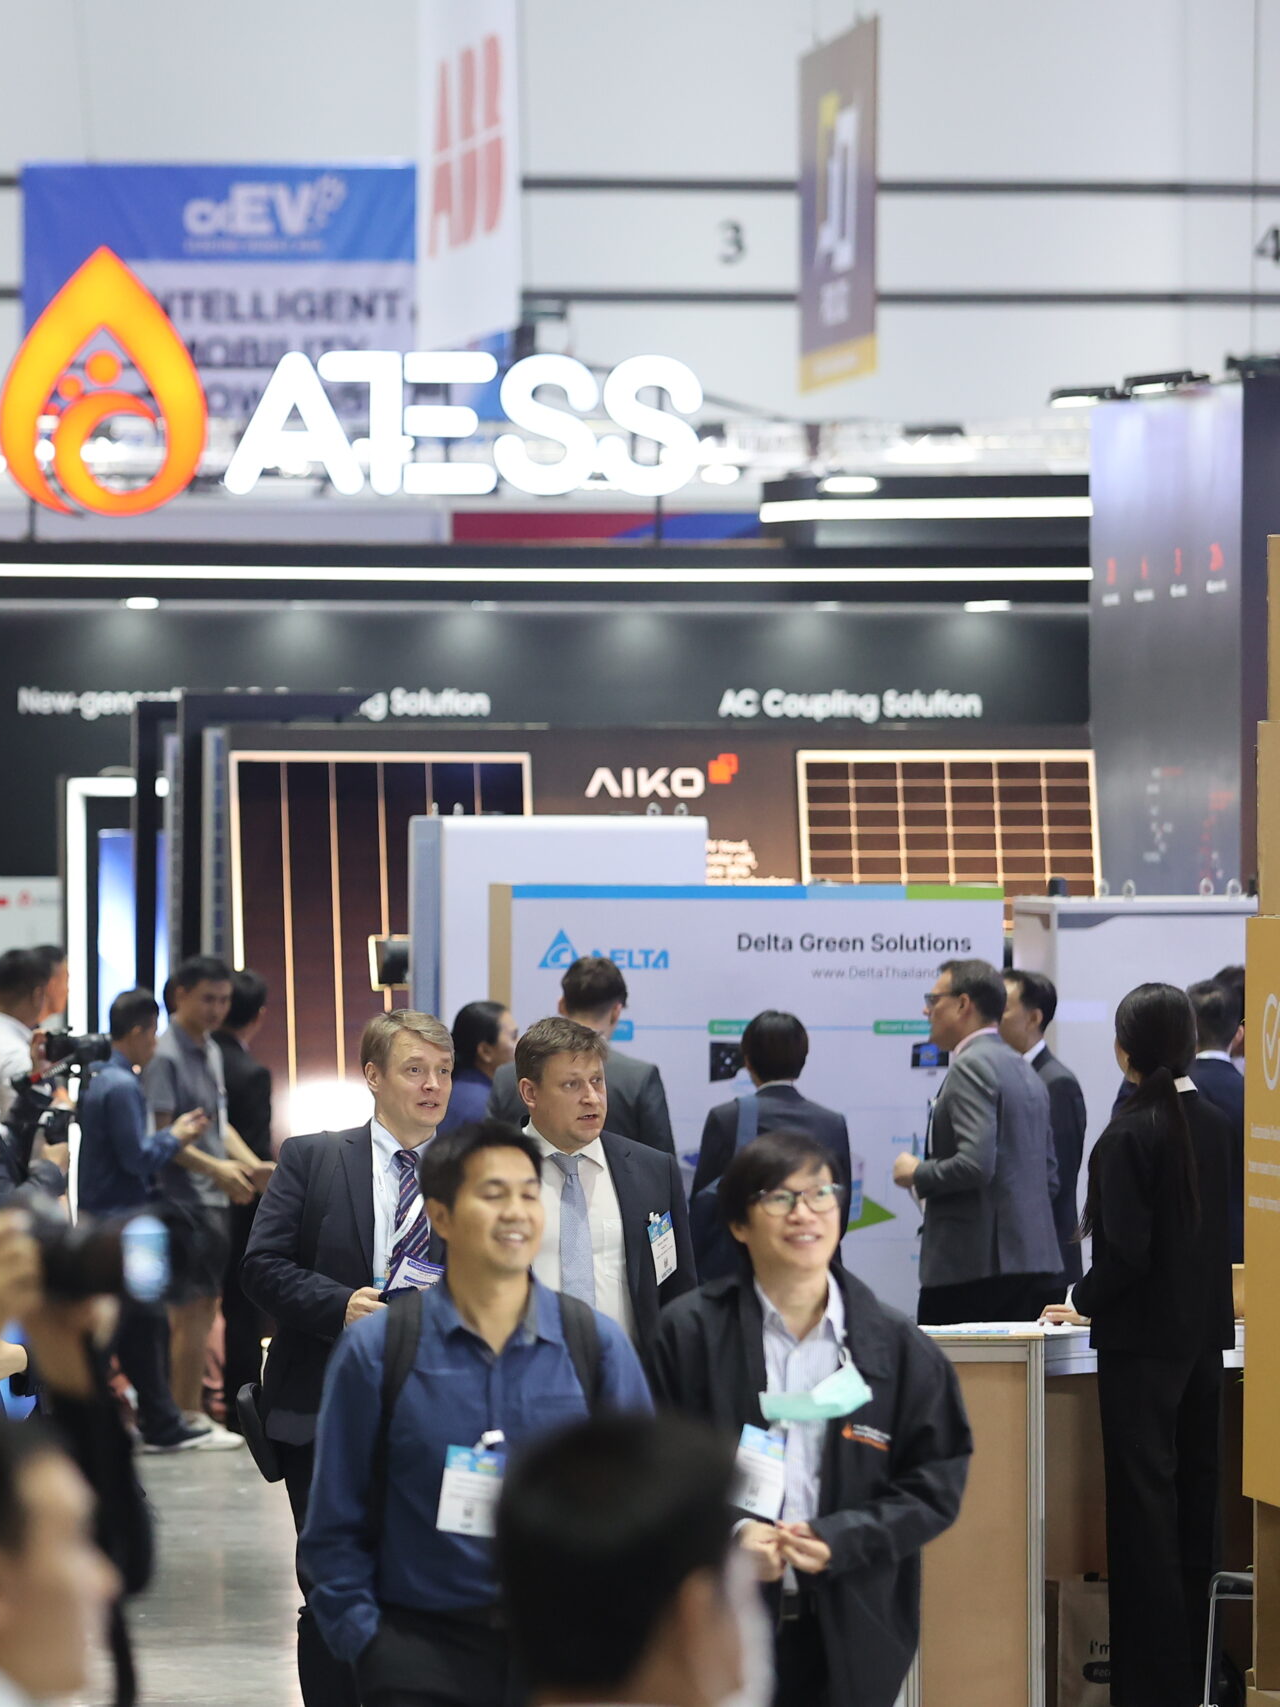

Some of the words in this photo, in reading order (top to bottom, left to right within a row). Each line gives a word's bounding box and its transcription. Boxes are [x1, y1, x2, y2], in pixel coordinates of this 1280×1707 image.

[720, 221, 745, 264] 3
[223, 350, 703, 496] ATESS
[718, 688, 761, 718] AC
[762, 688, 881, 724] Coupling
[882, 688, 983, 719] Solution
[585, 766, 704, 798] AIKO
[737, 933, 793, 951] Delta
[800, 933, 864, 952] Green
[871, 932, 972, 952] Solutions
